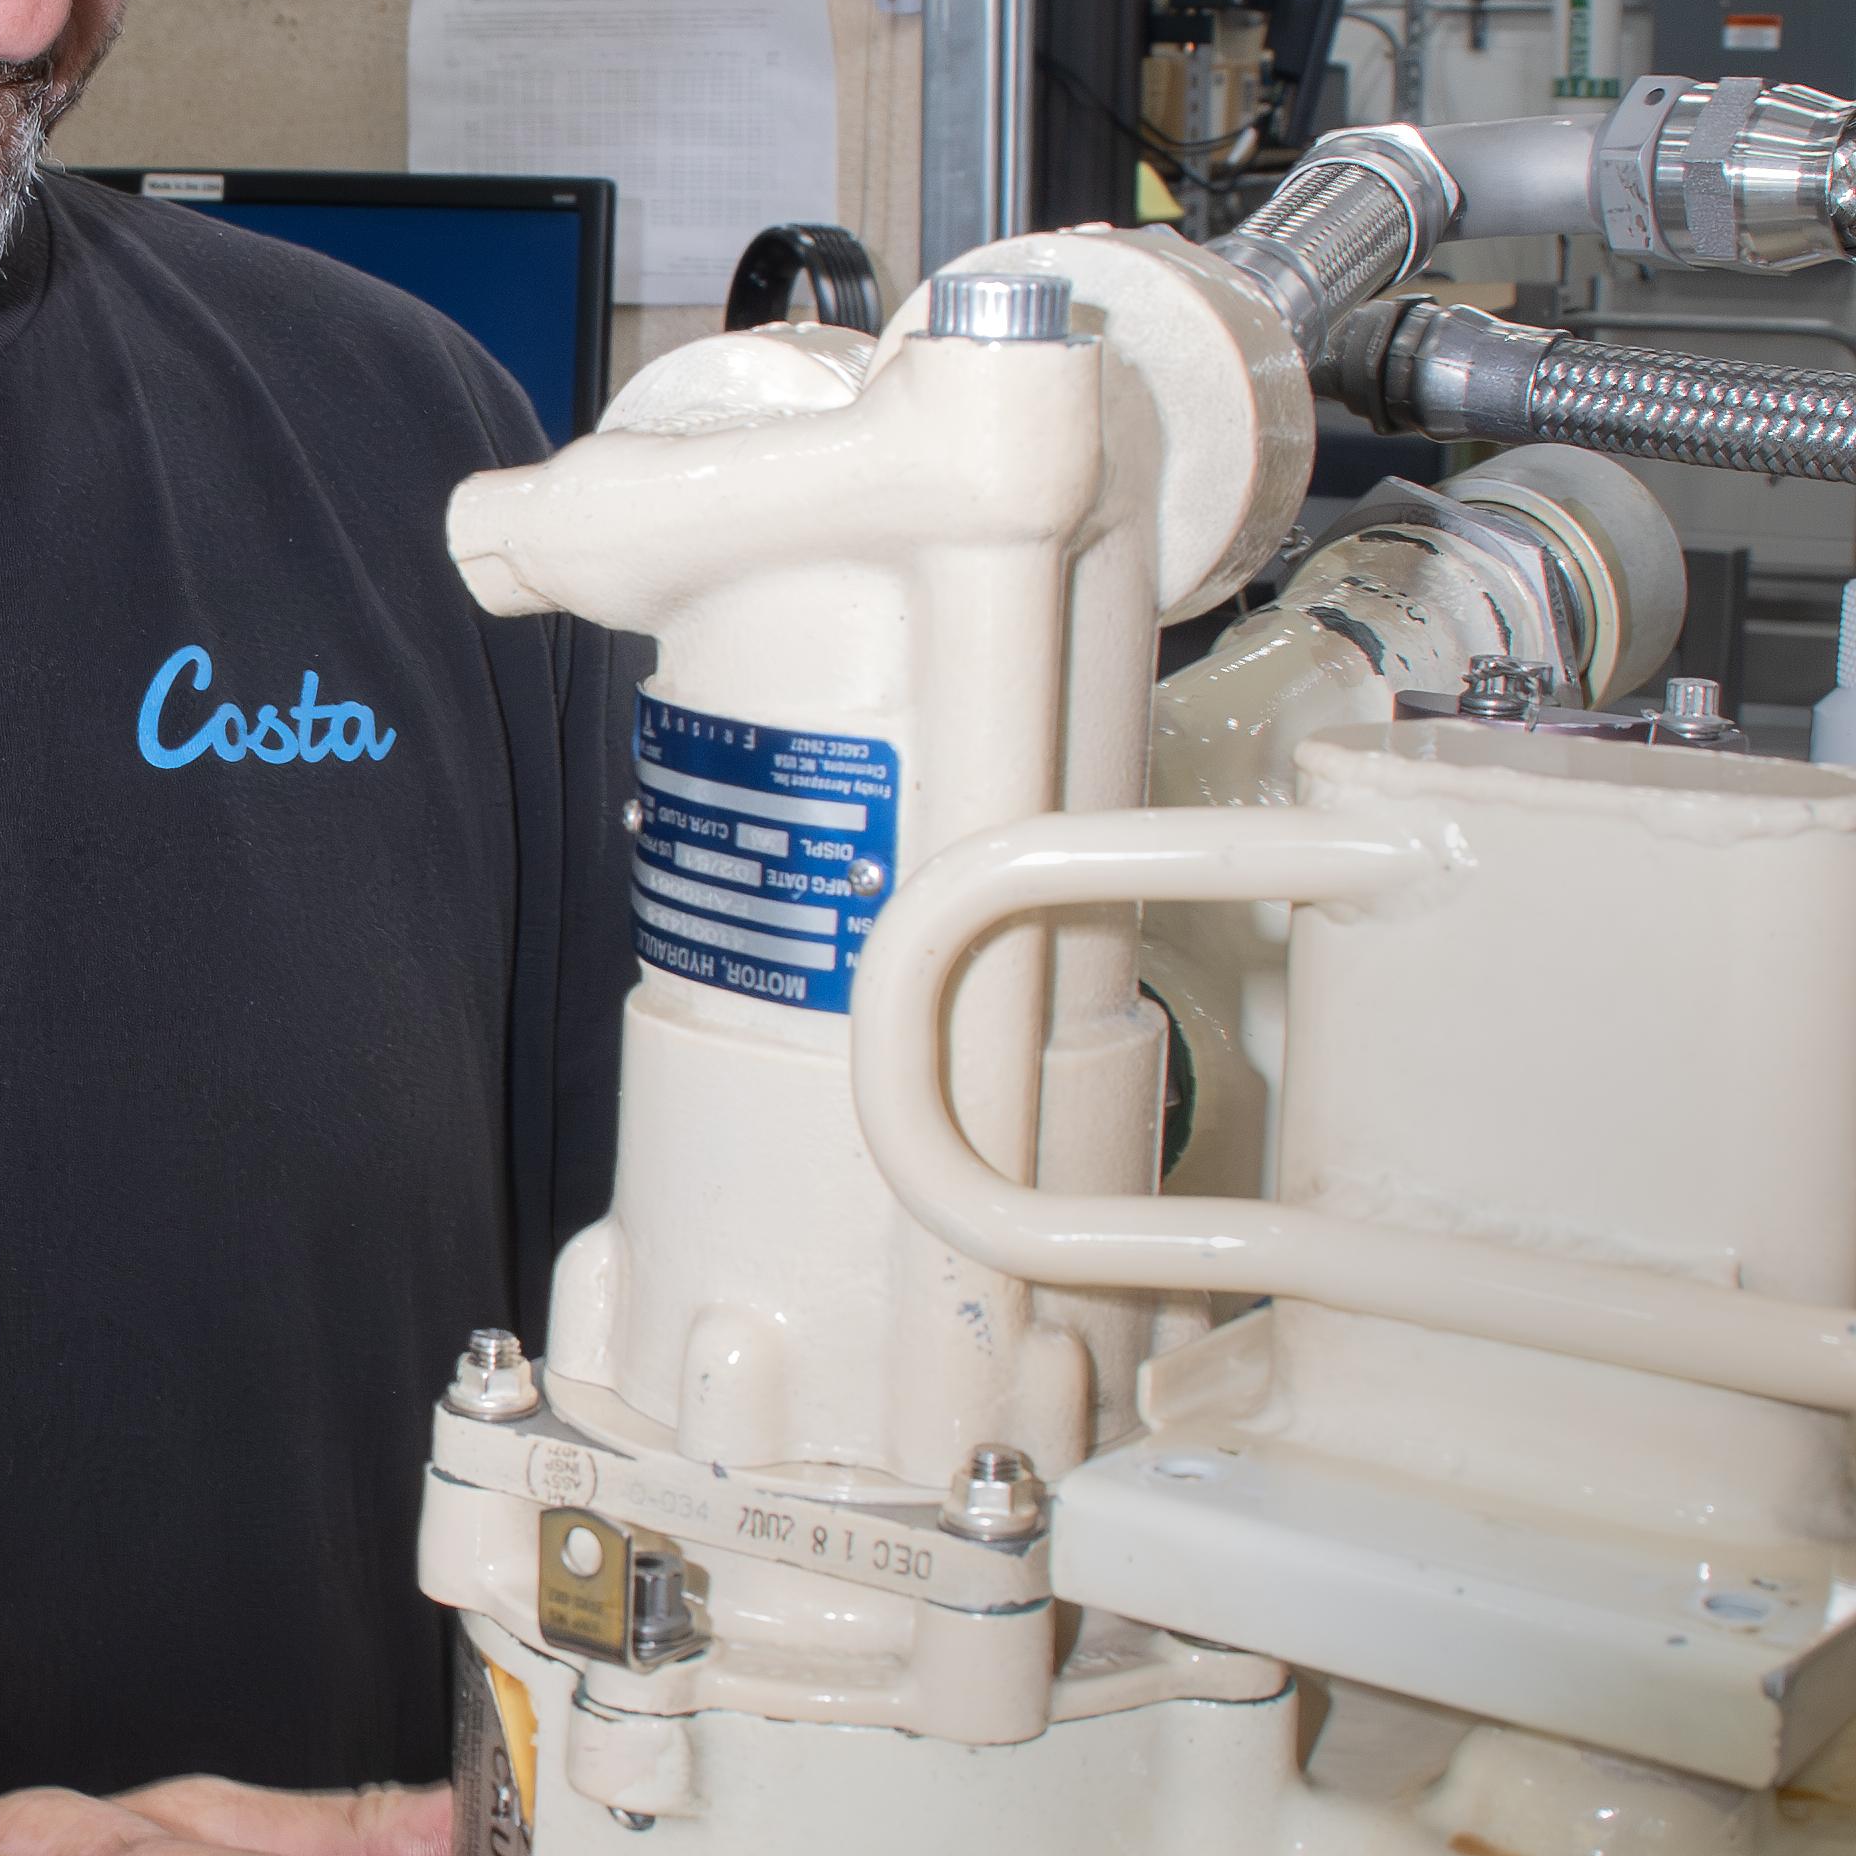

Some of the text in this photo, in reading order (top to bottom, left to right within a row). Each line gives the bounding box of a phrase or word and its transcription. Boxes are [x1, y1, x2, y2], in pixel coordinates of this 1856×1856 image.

[138, 644, 397, 769] Costa
[799, 838, 854, 862] DISPL
[767, 869, 852, 897] MFG DATE
[721, 955, 806, 1001] MOTOR,
[875, 1539, 933, 1582] DEC
